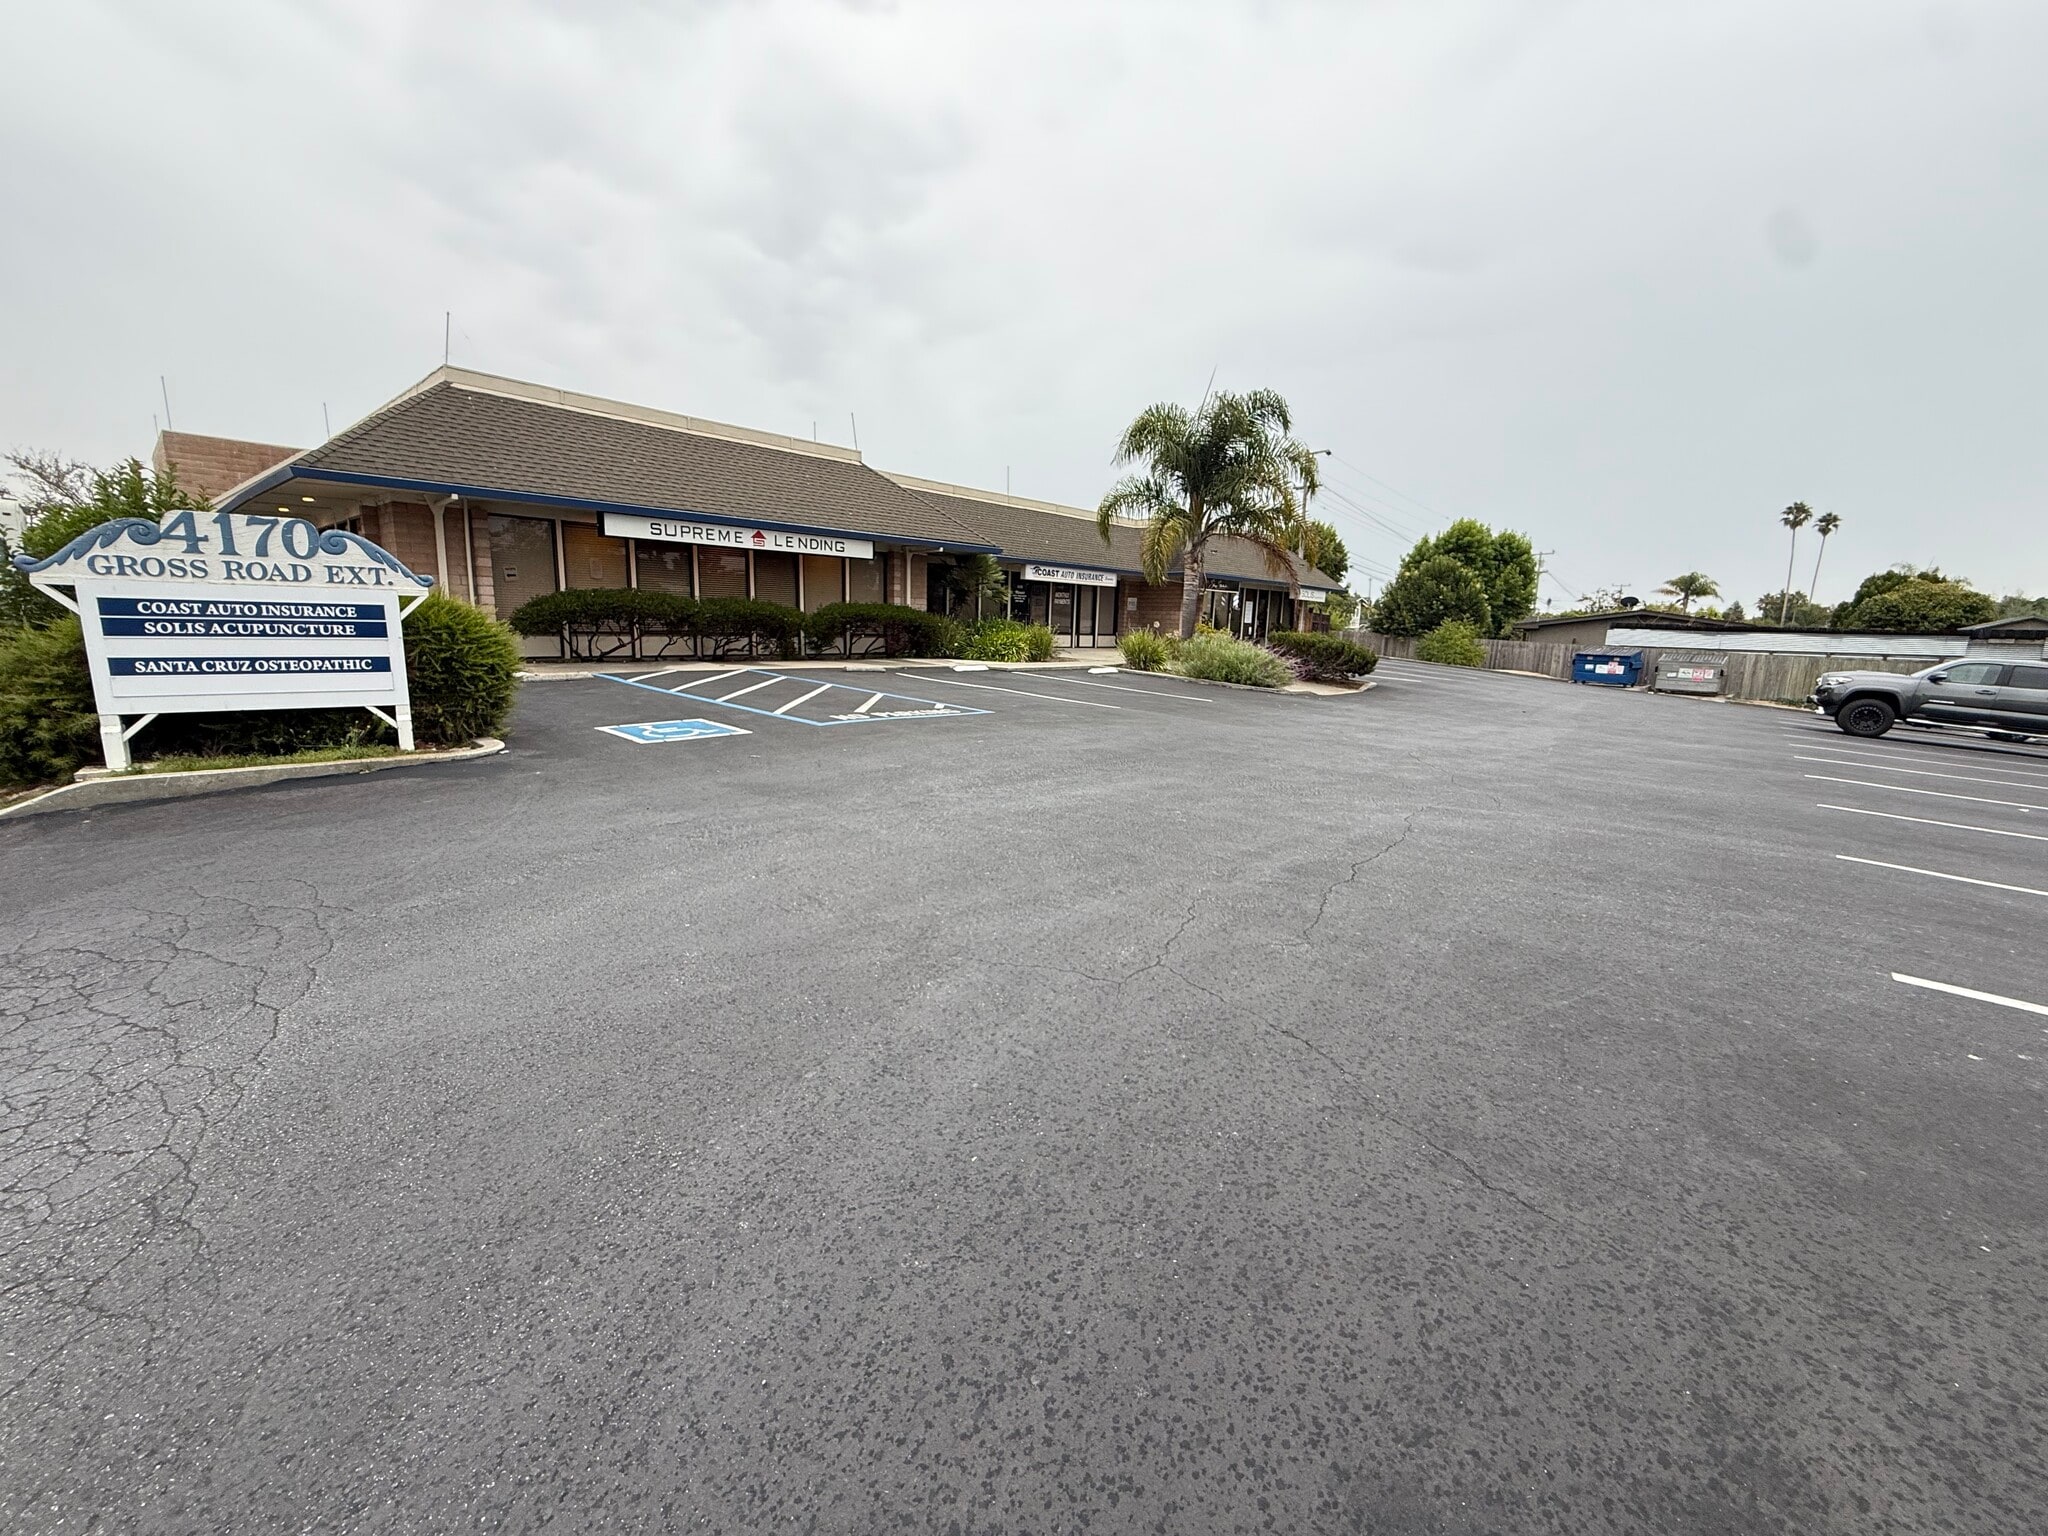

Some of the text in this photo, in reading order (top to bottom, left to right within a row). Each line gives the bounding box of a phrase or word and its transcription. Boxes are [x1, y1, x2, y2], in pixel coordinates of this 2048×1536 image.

[159, 510, 321, 560] 4170
[650, 522, 846, 553] SUPREME LENDING
[87, 553, 394, 586] GROSS ROAD EXT.
[1037, 568, 1059, 577] COAST
[1061, 571, 1074, 579] AUTO
[1077, 572, 1104, 581] INSURANCE
[136, 601, 358, 619] COAST AUTO INSURANCE
[144, 621, 357, 637] SOLIS ACUPUNCTURE
[134, 658, 373, 674] SANTA CRUZ OSTEOPATHIC
